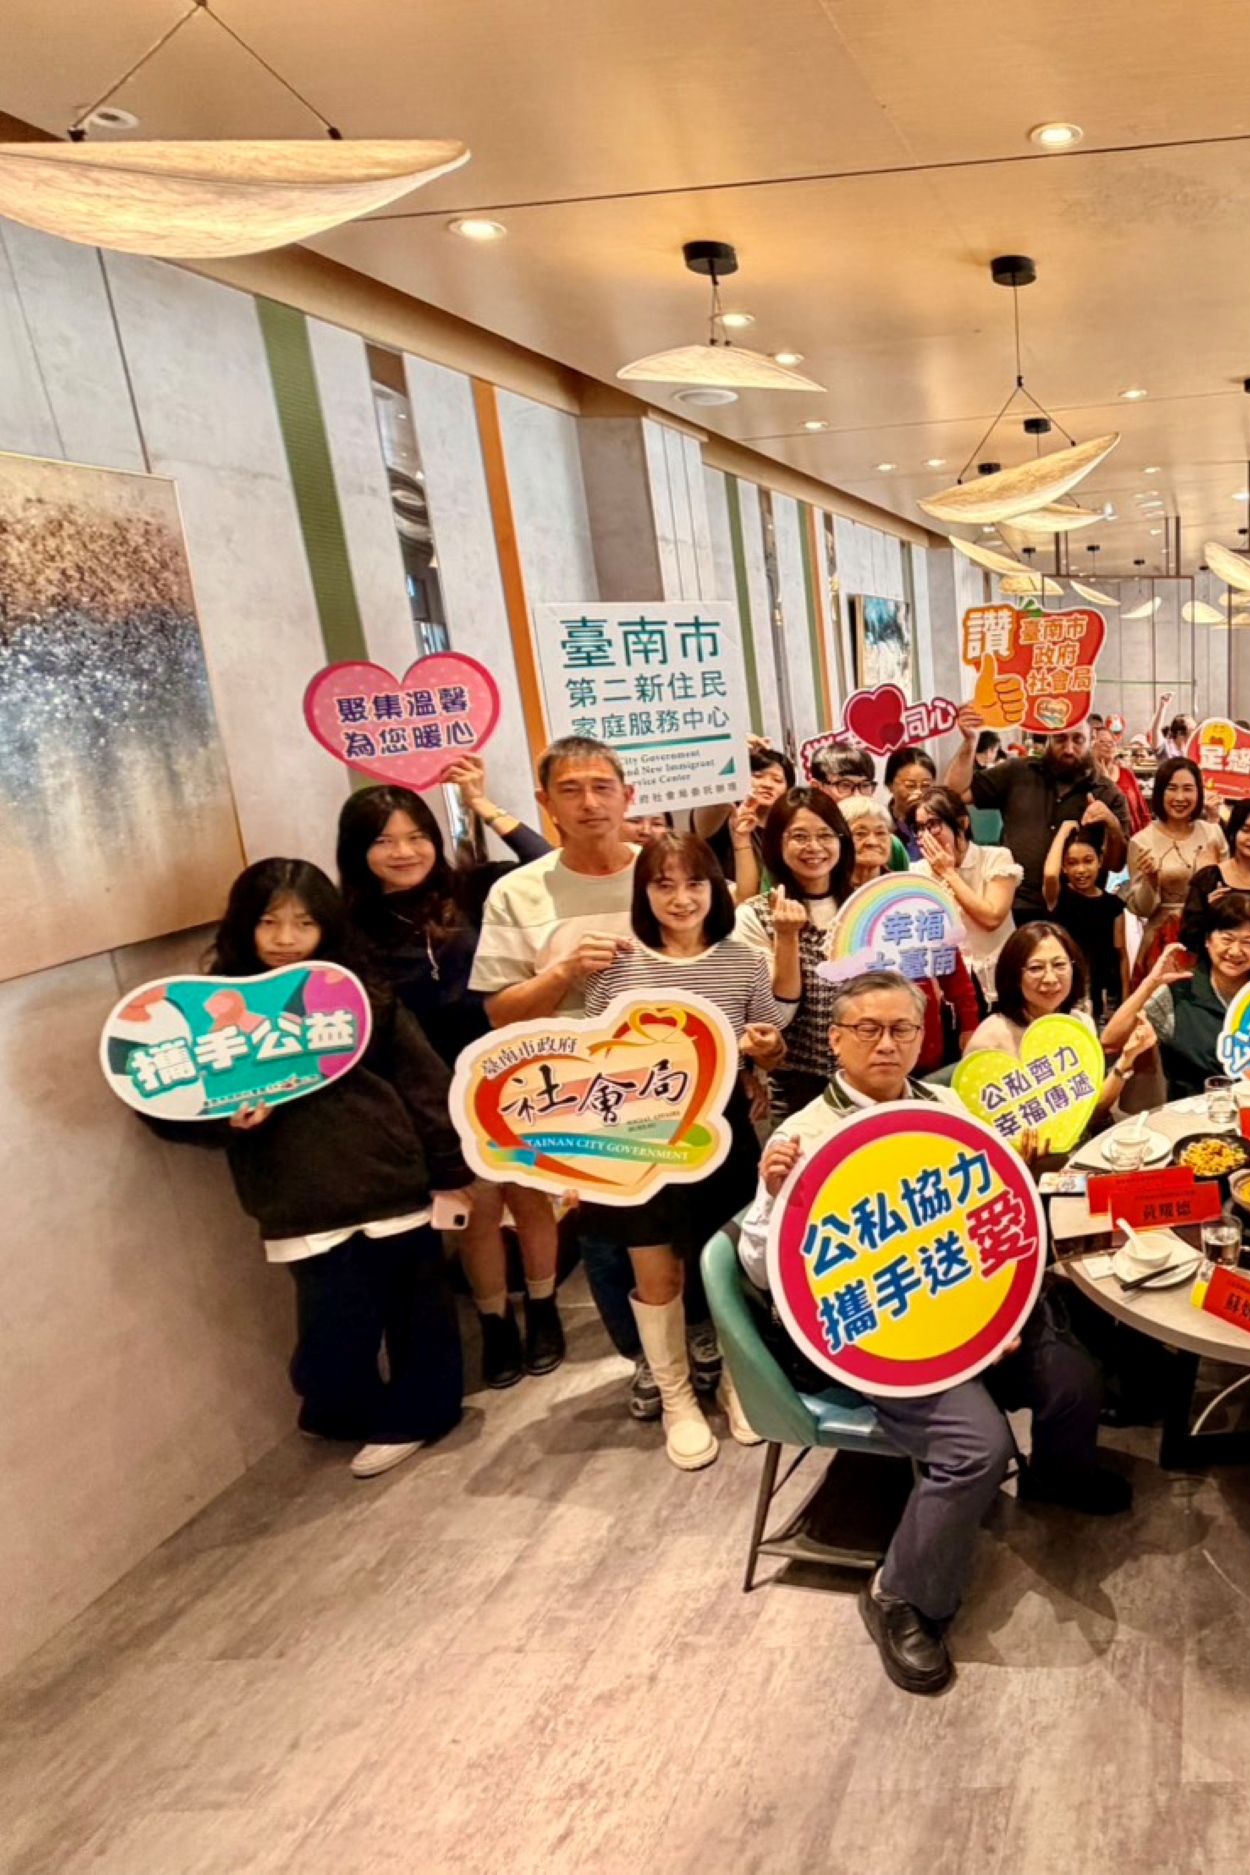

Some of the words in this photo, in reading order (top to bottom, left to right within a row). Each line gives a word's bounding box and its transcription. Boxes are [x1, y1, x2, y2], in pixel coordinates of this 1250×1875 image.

[560, 615, 720, 668] 臺南市
[966, 610, 1013, 658] 讚
[1021, 615, 1087, 643] 臺南市
[1033, 642, 1079, 667] 政府
[565, 670, 727, 708] 第二新住民
[1027, 667, 1093, 694] 社會局
[336, 686, 468, 723] 聚集溫馨
[571, 706, 729, 739] 家庭服務中心
[343, 720, 475, 758] 為您暖心
[640, 749, 701, 763] Government
[642, 766, 663, 775] New
[665, 758, 715, 773] Immigrant
[659, 773, 691, 785] Center
[881, 910, 945, 946] 幸福
[131, 1010, 355, 1092] 攜手公益
[482, 1036, 577, 1075] 臺南市政府
[500, 1058, 689, 1124] 社會局
[981, 1046, 1079, 1111] 公私齊力
[994, 1072, 1095, 1138] 幸福傳遞
[527, 1136, 574, 1149] TAINAN
[576, 1138, 604, 1151] CITY
[606, 1141, 689, 1161] GOVERNMENT
[803, 1151, 993, 1278] 公私協力
[820, 1189, 1037, 1353] 攜手送愛
